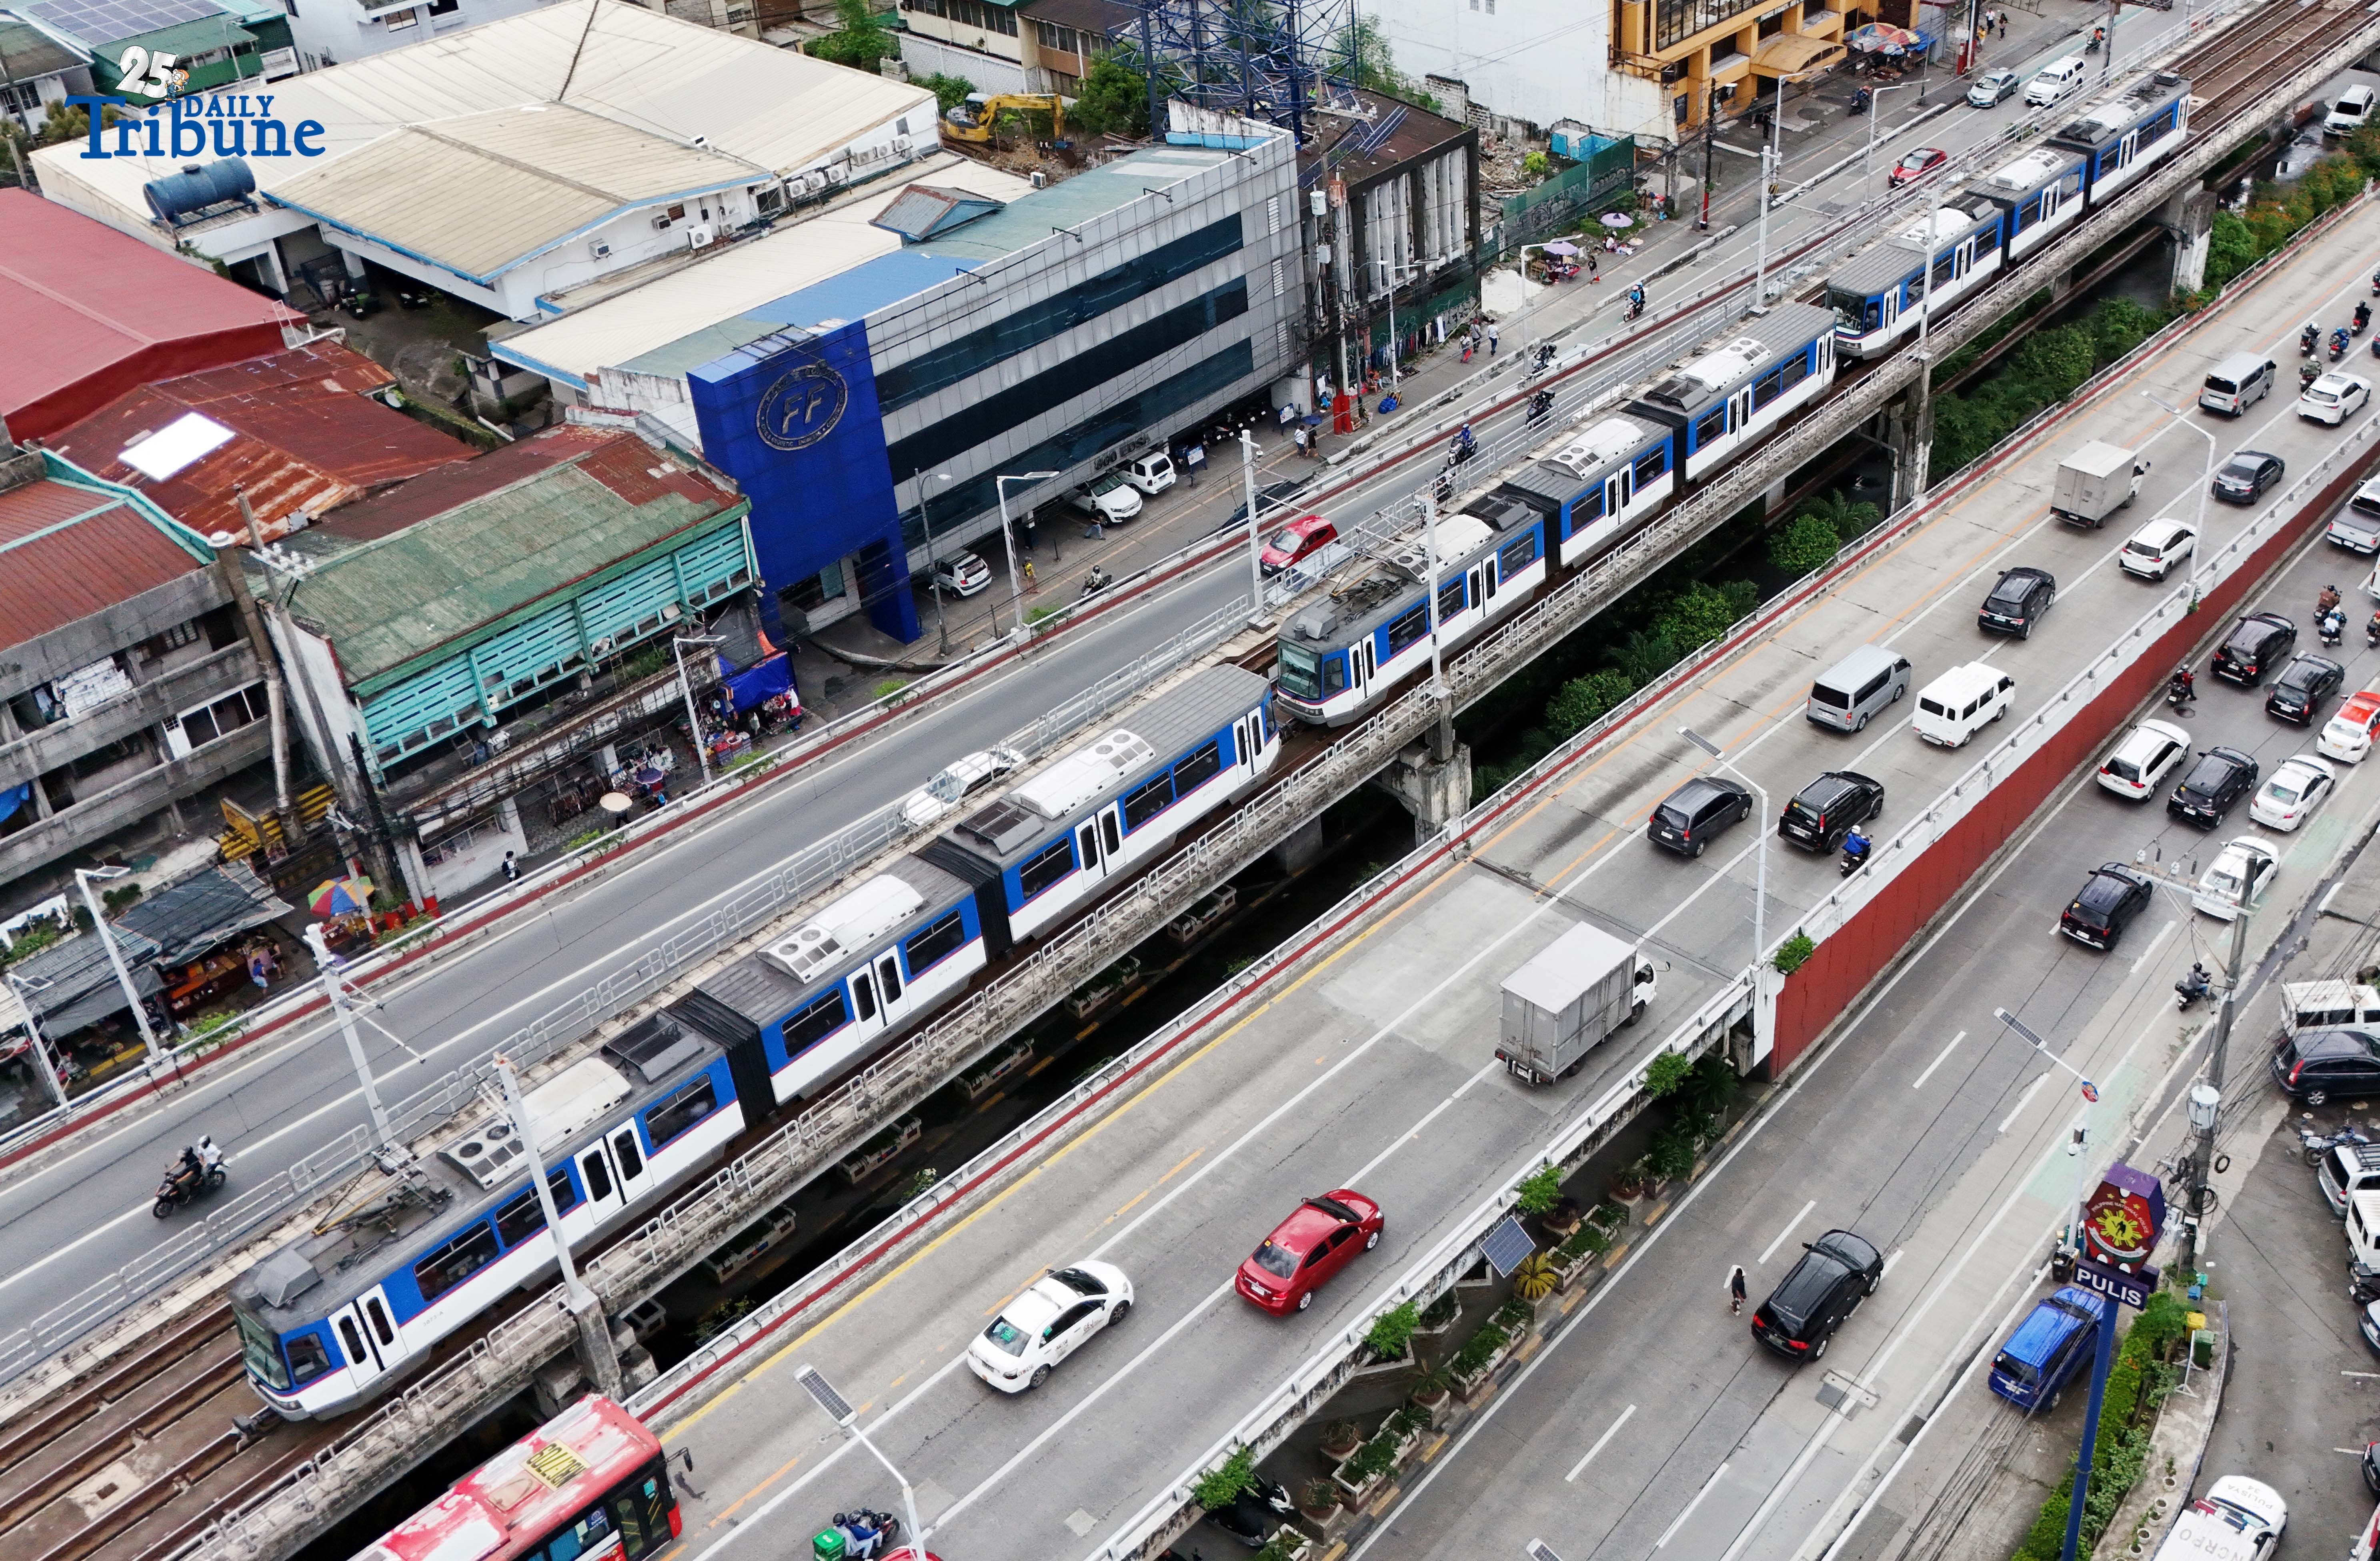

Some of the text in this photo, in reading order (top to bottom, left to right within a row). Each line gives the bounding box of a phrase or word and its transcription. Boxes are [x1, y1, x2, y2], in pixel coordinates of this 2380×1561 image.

[782, 382, 825, 434] FF
[2114, 1202, 2138, 1218] NATIONAL
[2138, 1217, 2150, 1234] POLICE
[2077, 1267, 2142, 1306] PULIS
[2227, 1483, 2273, 1510] PULISYA
[2247, 1484, 2260, 1493] 34
